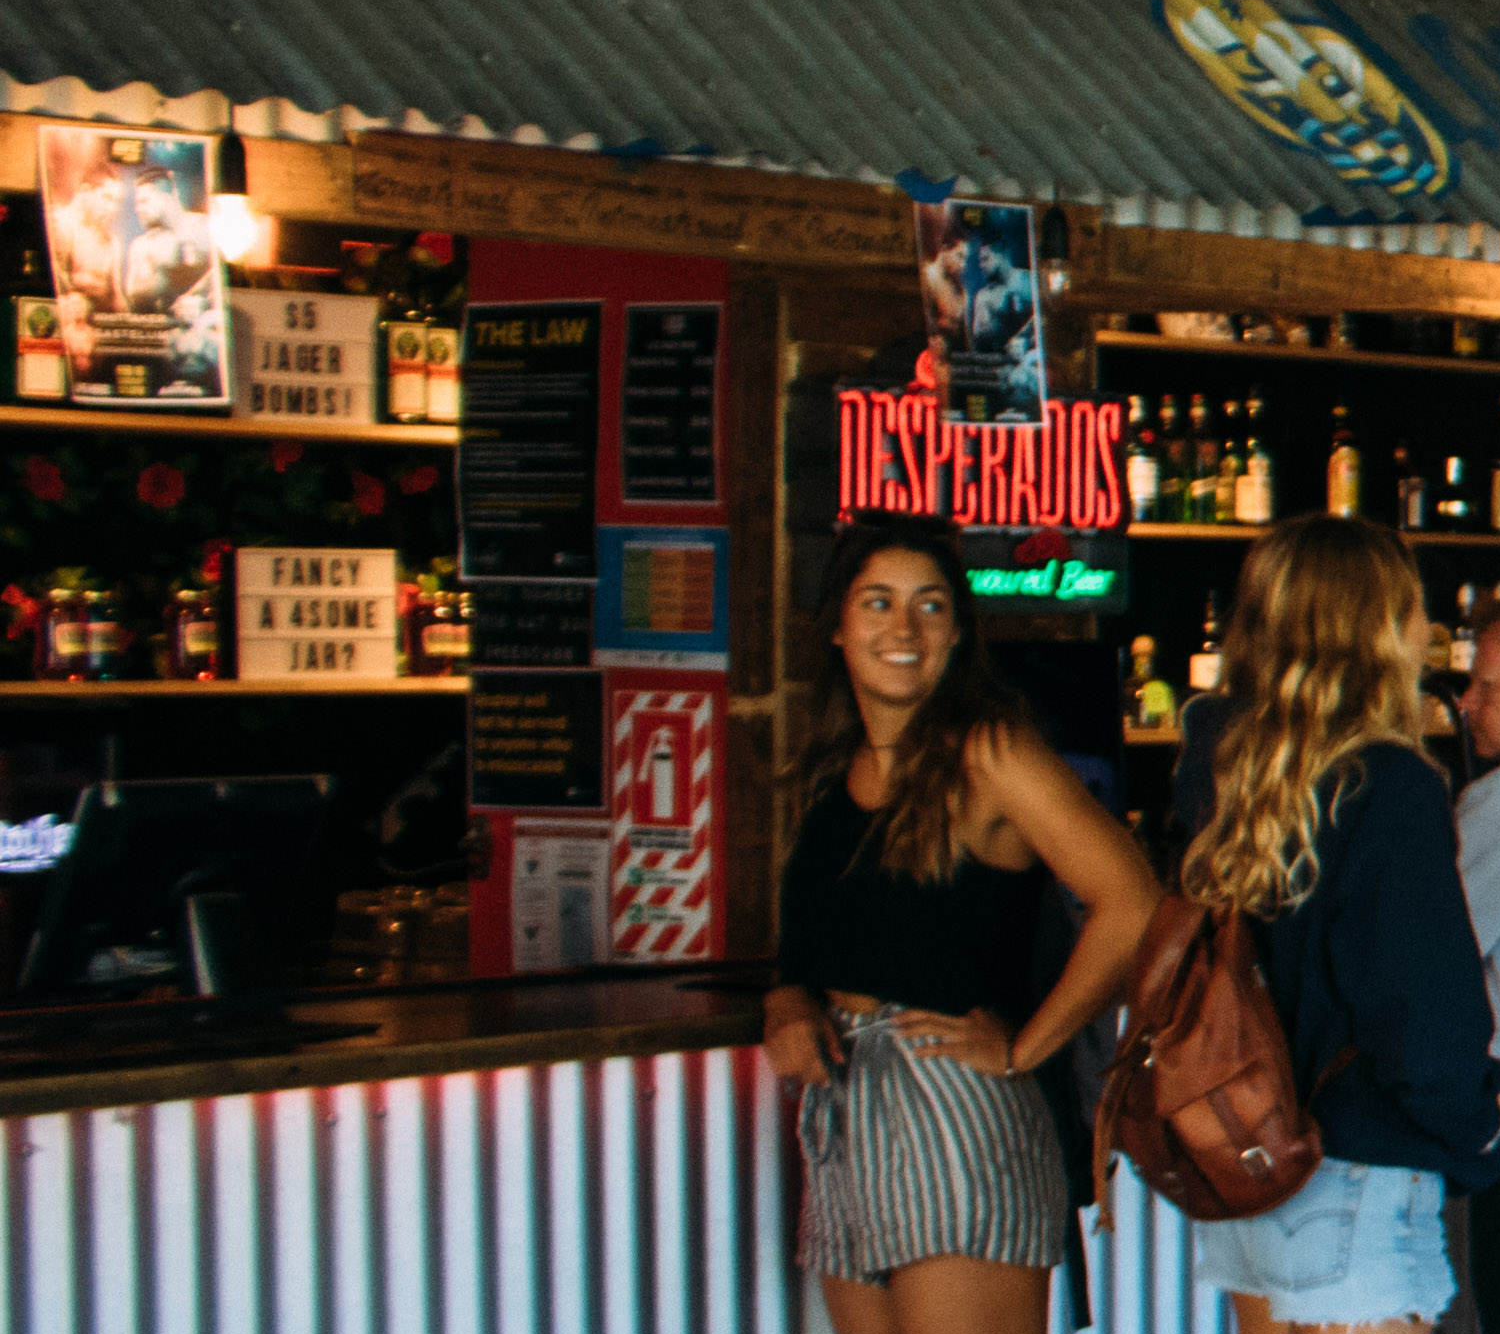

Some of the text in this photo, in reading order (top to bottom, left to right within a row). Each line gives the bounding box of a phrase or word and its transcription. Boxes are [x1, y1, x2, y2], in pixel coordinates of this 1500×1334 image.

[474, 317, 589, 347] THE LAW
[261, 341, 341, 373] JAGER
[251, 383, 350, 416] BOMBS!
[839, 390, 1121, 529] DESPERADOS
[272, 556, 361, 586] FANCY
[966, 559, 1116, 599] voured Beer
[260, 599, 376, 629] A 4SOME
[290, 642, 356, 671] JAR?
